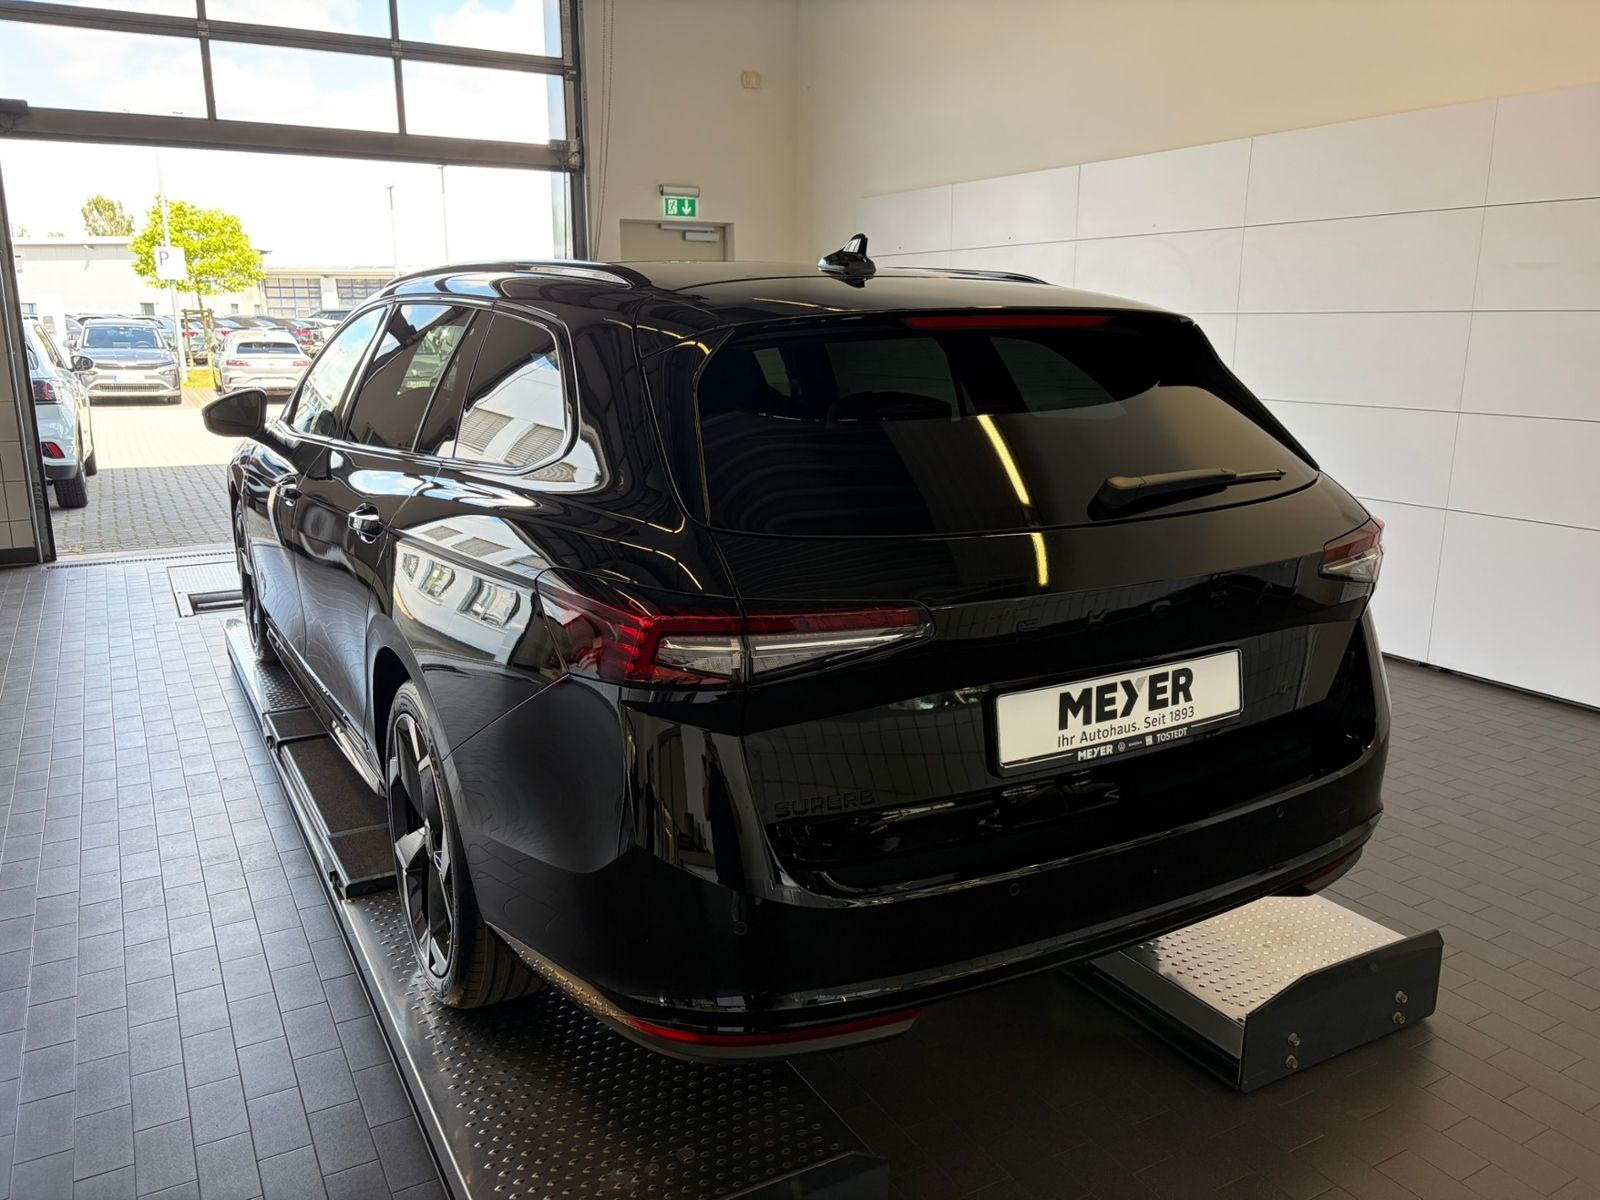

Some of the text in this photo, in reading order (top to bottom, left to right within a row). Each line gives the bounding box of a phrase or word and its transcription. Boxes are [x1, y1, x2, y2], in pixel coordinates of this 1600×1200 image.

[159, 250, 169, 266] P
[1058, 667, 1194, 730] MEYER
[1057, 705, 1195, 748] Ihr Autohaus. Seit 1893
[1077, 744, 1114, 761] MEYER
[1156, 727, 1188, 743] TOSTEDT
[774, 790, 875, 817] SUPERB
